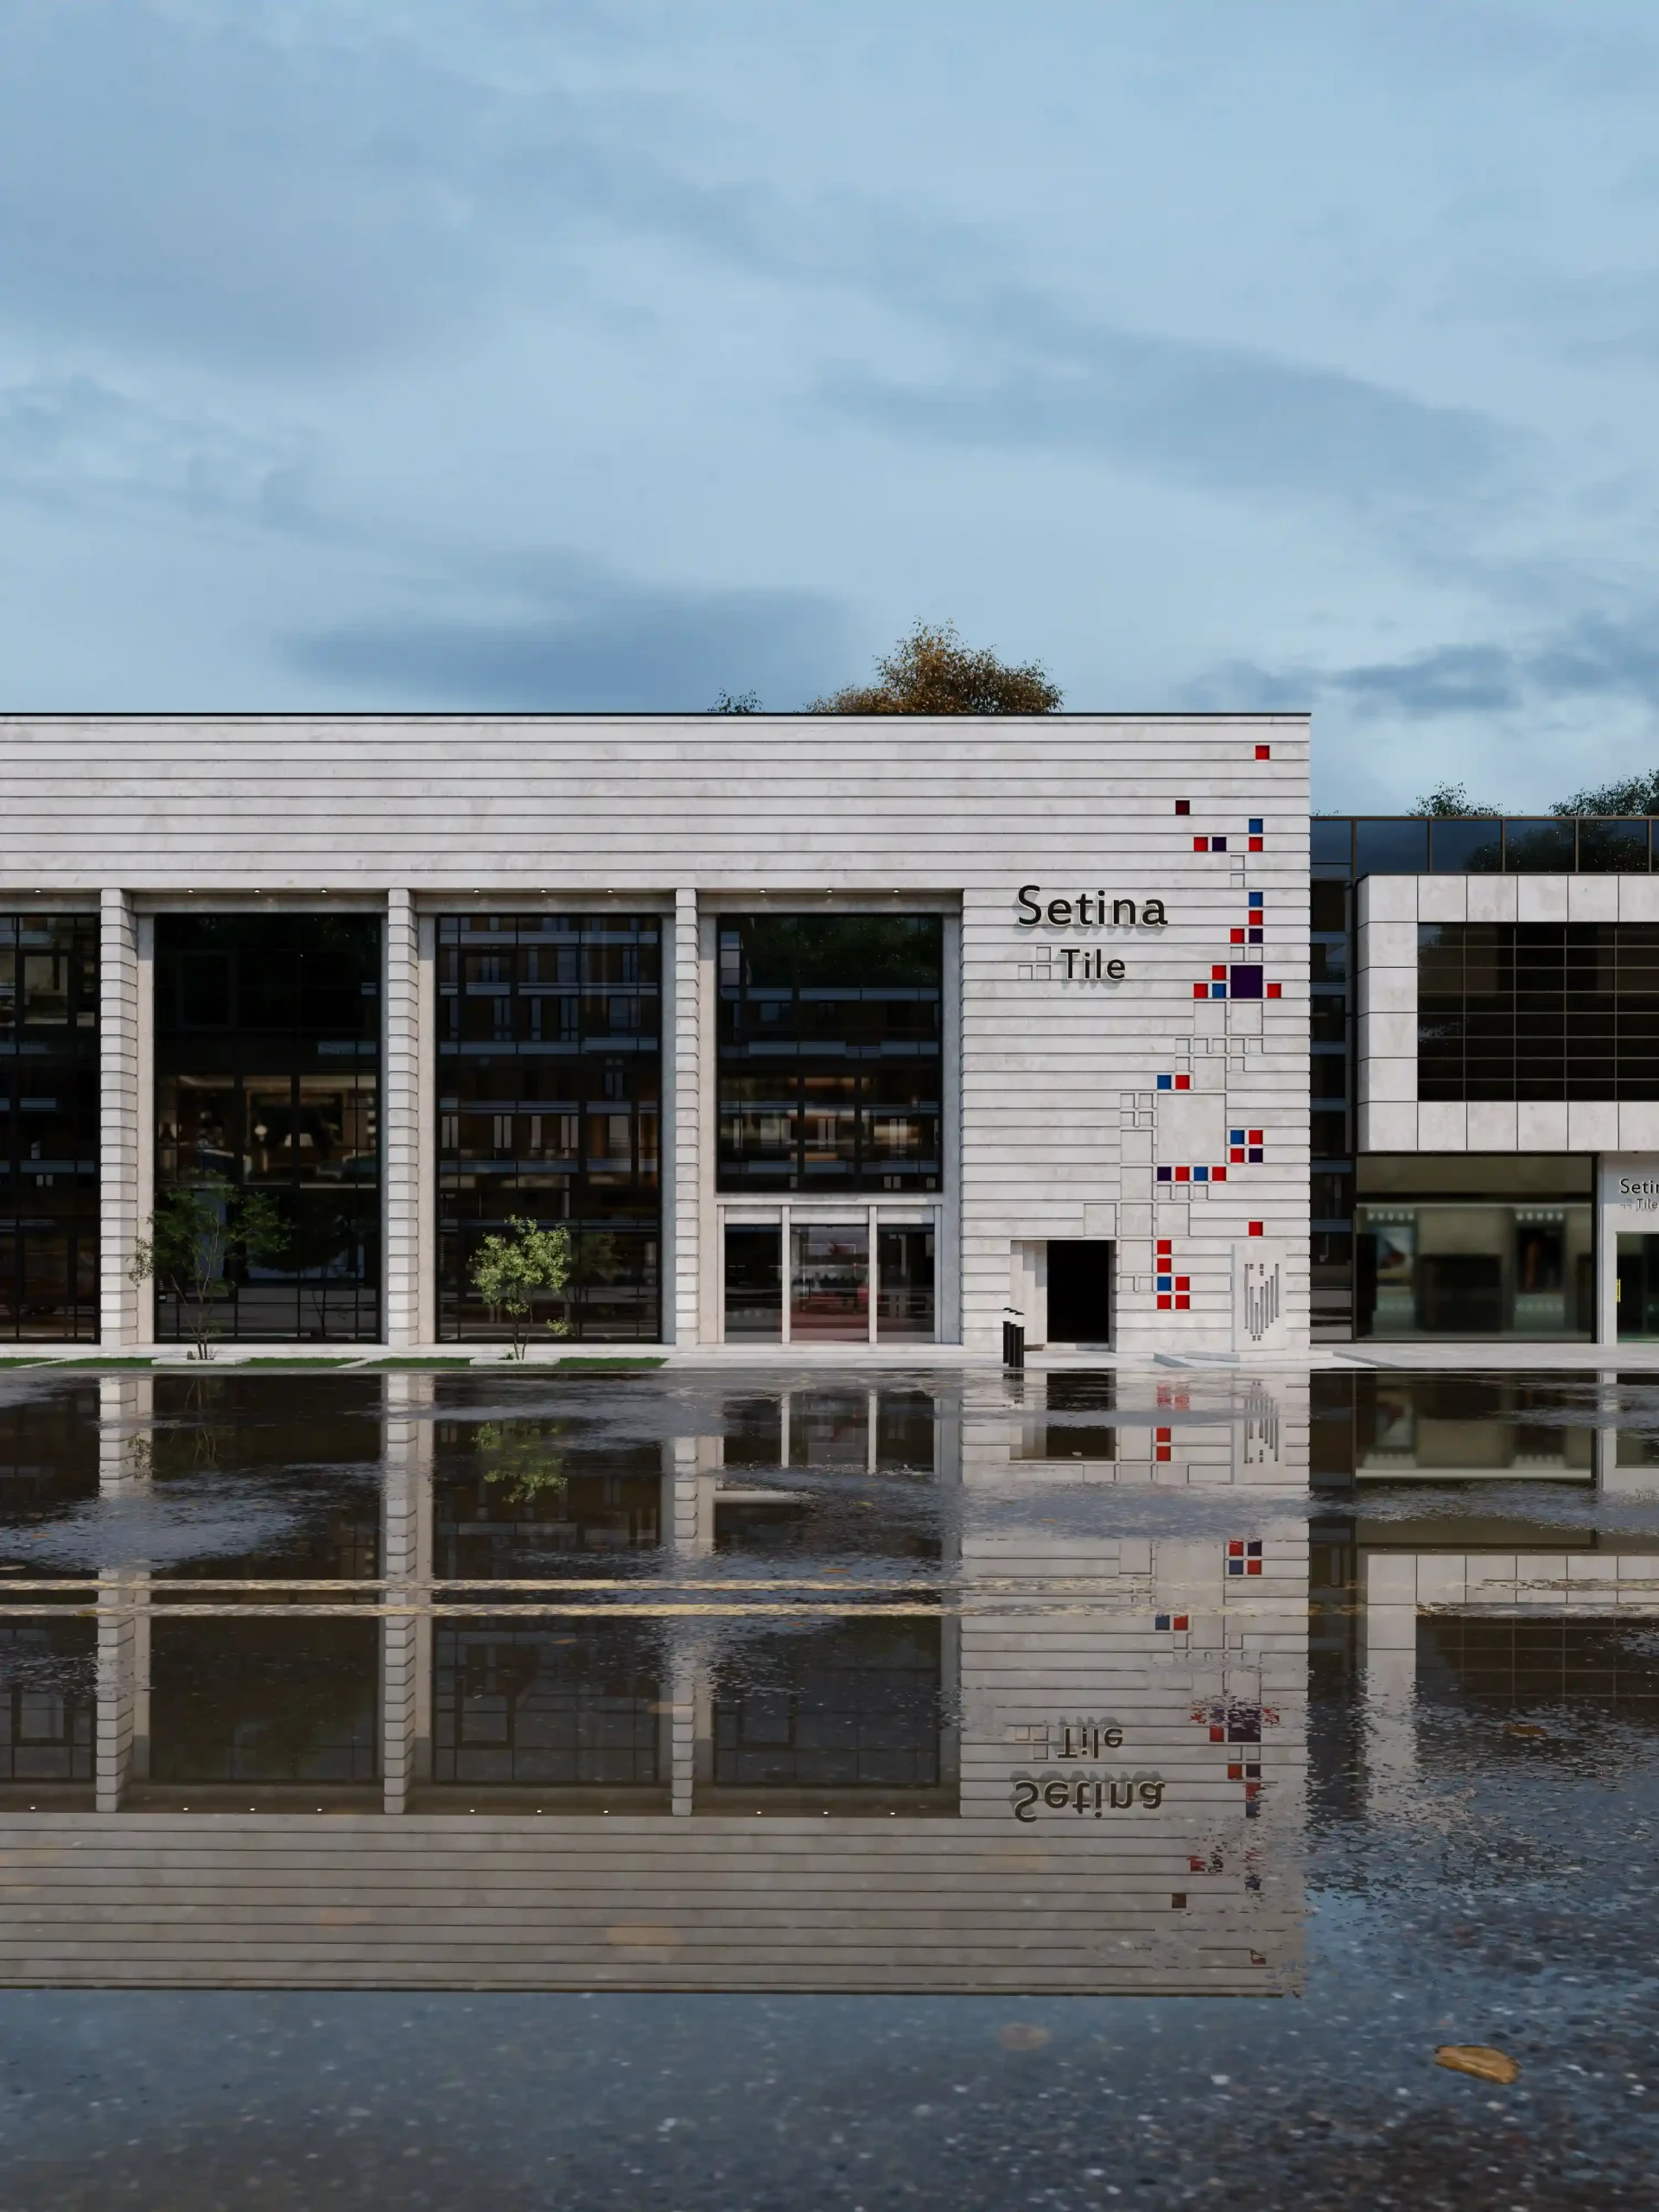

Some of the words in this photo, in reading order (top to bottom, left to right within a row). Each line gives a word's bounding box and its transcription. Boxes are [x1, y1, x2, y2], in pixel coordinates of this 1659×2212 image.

[1018, 885, 1168, 925] Setina
[1060, 949, 1126, 980] Tile
[1636, 1198, 1658, 1210] Tile
